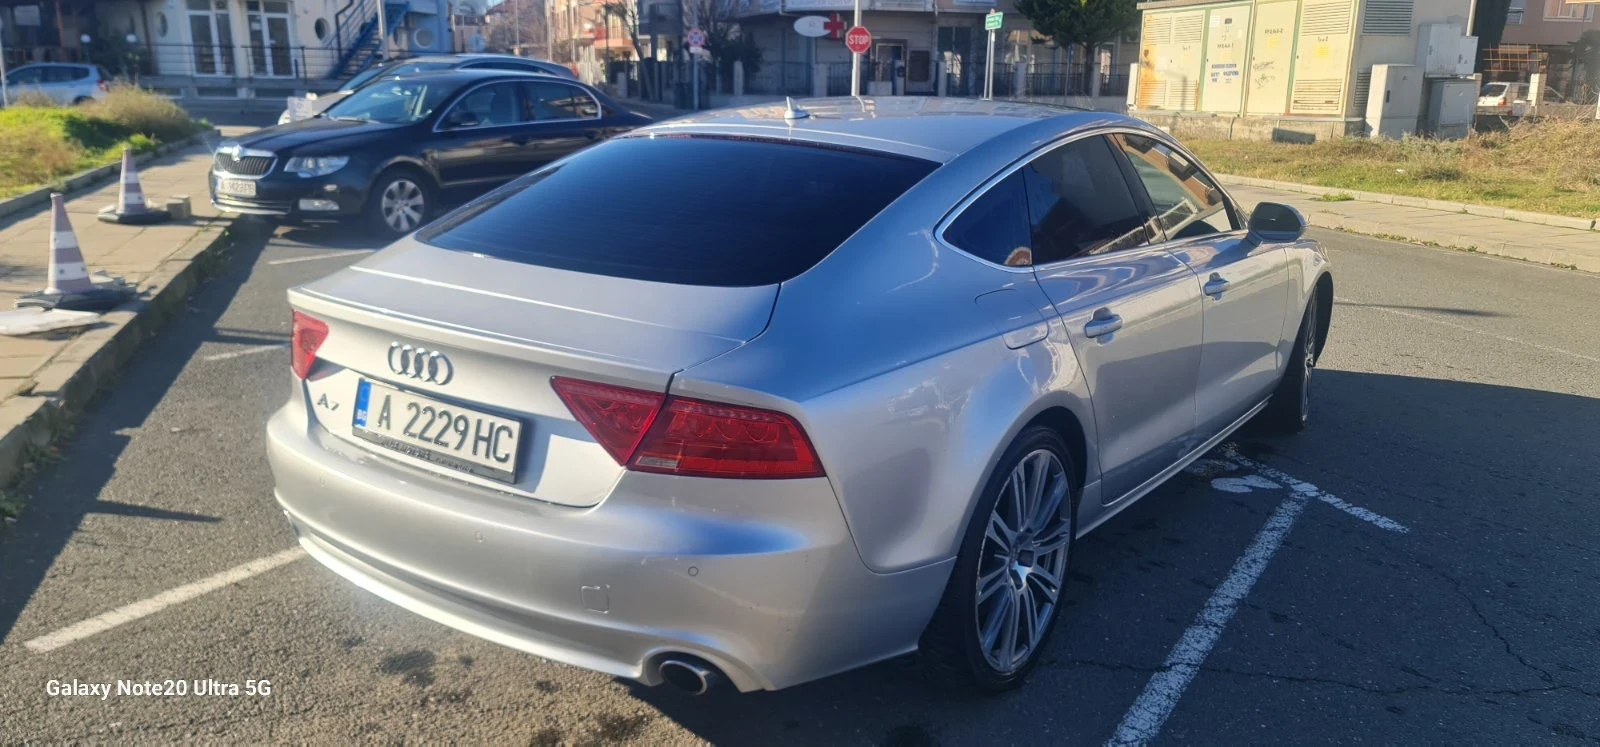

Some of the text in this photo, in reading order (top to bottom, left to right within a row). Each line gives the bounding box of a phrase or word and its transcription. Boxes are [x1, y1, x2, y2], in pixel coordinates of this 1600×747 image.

[848, 34, 868, 45] STOP
[317, 392, 339, 411] A7
[377, 394, 391, 430] A
